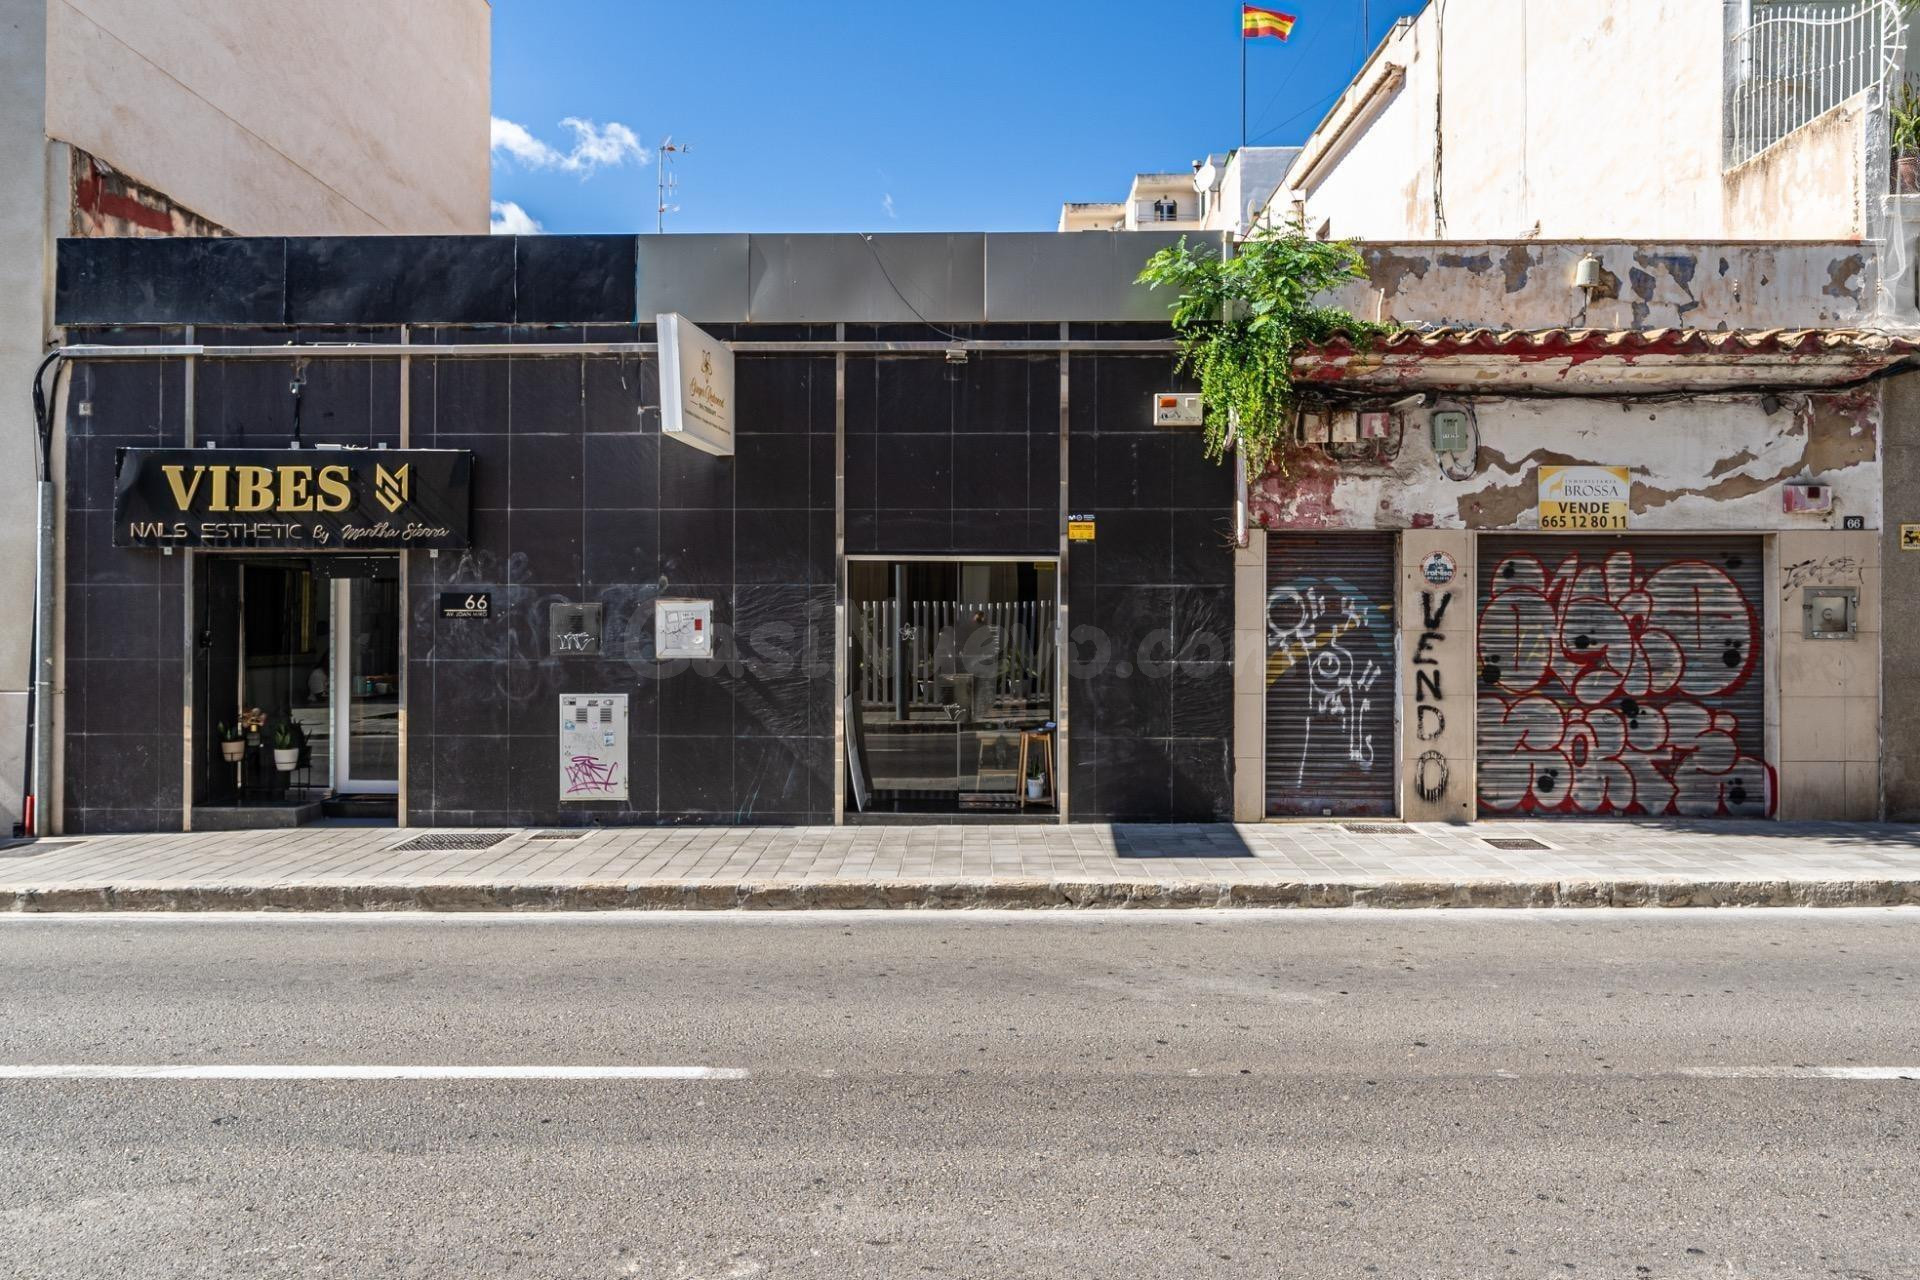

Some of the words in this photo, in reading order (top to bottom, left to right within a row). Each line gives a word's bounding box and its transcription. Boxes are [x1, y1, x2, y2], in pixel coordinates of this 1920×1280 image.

[162, 465, 351, 512] VIBES
[1565, 486, 1619, 496] BROSSA
[1558, 502, 1610, 513] VENDE
[1541, 515, 1567, 528] 665
[1571, 515, 1587, 528] 12
[1591, 515, 1608, 528] 80
[1612, 515, 1627, 528] 11
[1847, 518, 1861, 529] 66
[130, 522, 188, 539] NAILS
[200, 523, 302, 540] ESTHETIC
[312, 524, 329, 544] By
[342, 521, 400, 541] Martha
[465, 594, 488, 610] 66
[1413, 591, 1452, 803] VENDO
